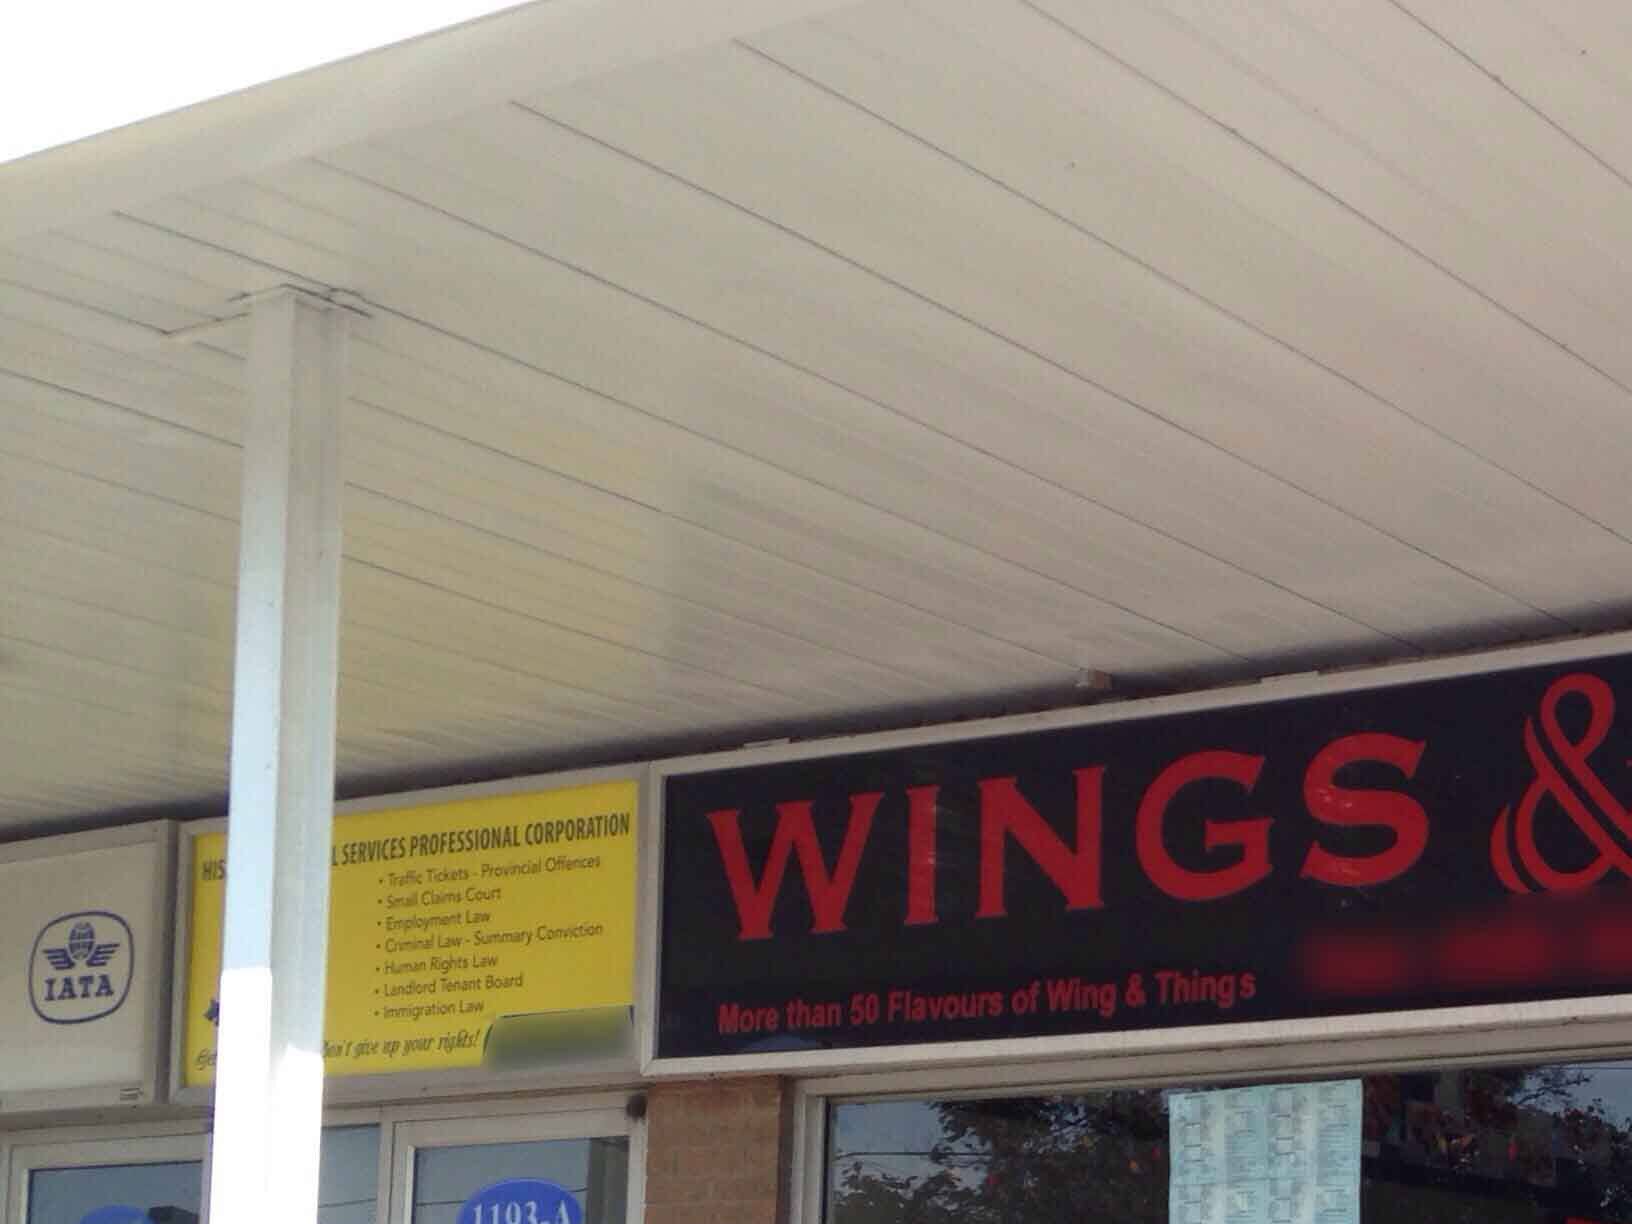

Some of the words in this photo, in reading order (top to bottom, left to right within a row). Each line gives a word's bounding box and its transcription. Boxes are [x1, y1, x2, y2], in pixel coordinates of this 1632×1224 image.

[341, 836, 405, 865] SERVICES
[410, 825, 520, 856] PROFESSIONAL
[525, 813, 630, 845] CORPORATION
[708, 733, 1429, 942] WINGS
[428, 867, 469, 882] Tickets
[481, 860, 541, 878] Provincial
[466, 909, 490, 923] Law
[473, 954, 497, 968] Law
[45, 974, 114, 1001] IATA
[486, 972, 523, 988] Board
[718, 1003, 778, 1034] More
[786, 999, 841, 1028] than
[850, 993, 880, 1024] 50
[887, 988, 1003, 1022] Flavours
[1012, 979, 1040, 1014] of
[1047, 976, 1116, 1017] Wing
[1125, 973, 1147, 1007] &
[1156, 969, 1256, 1008] Things
